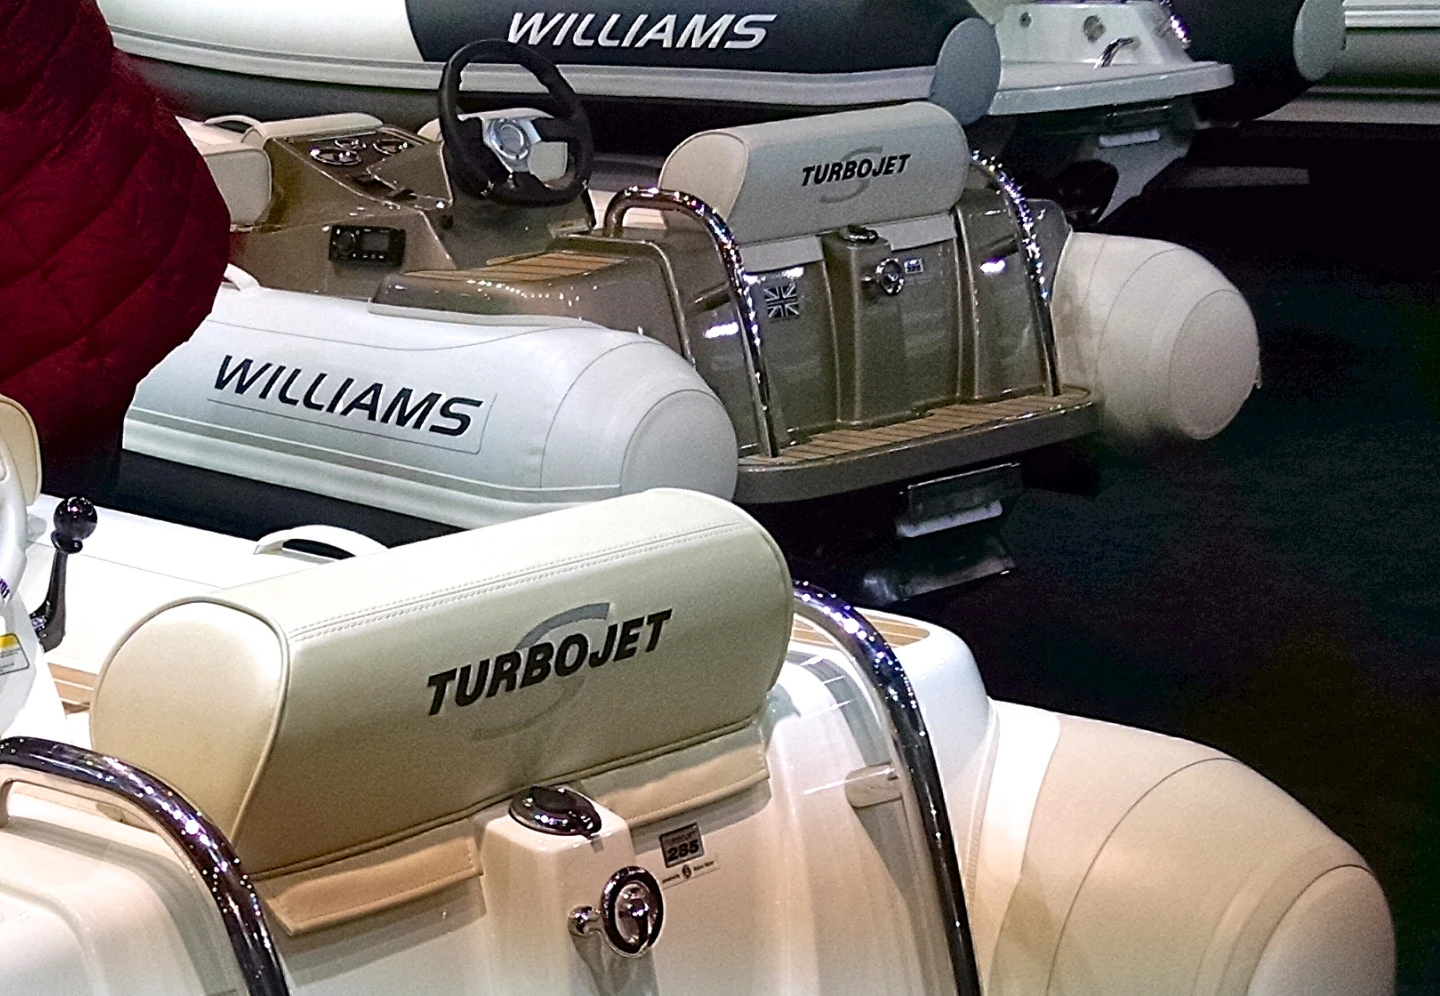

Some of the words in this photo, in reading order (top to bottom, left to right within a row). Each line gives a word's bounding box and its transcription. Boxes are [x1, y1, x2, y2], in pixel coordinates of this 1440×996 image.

[508, 12, 778, 49] WILLIAMS
[802, 154, 911, 187] TURBOJET
[214, 355, 484, 436] WILLIAMS
[427, 609, 673, 716] TURBOJET
[667, 839, 699, 861] 285
